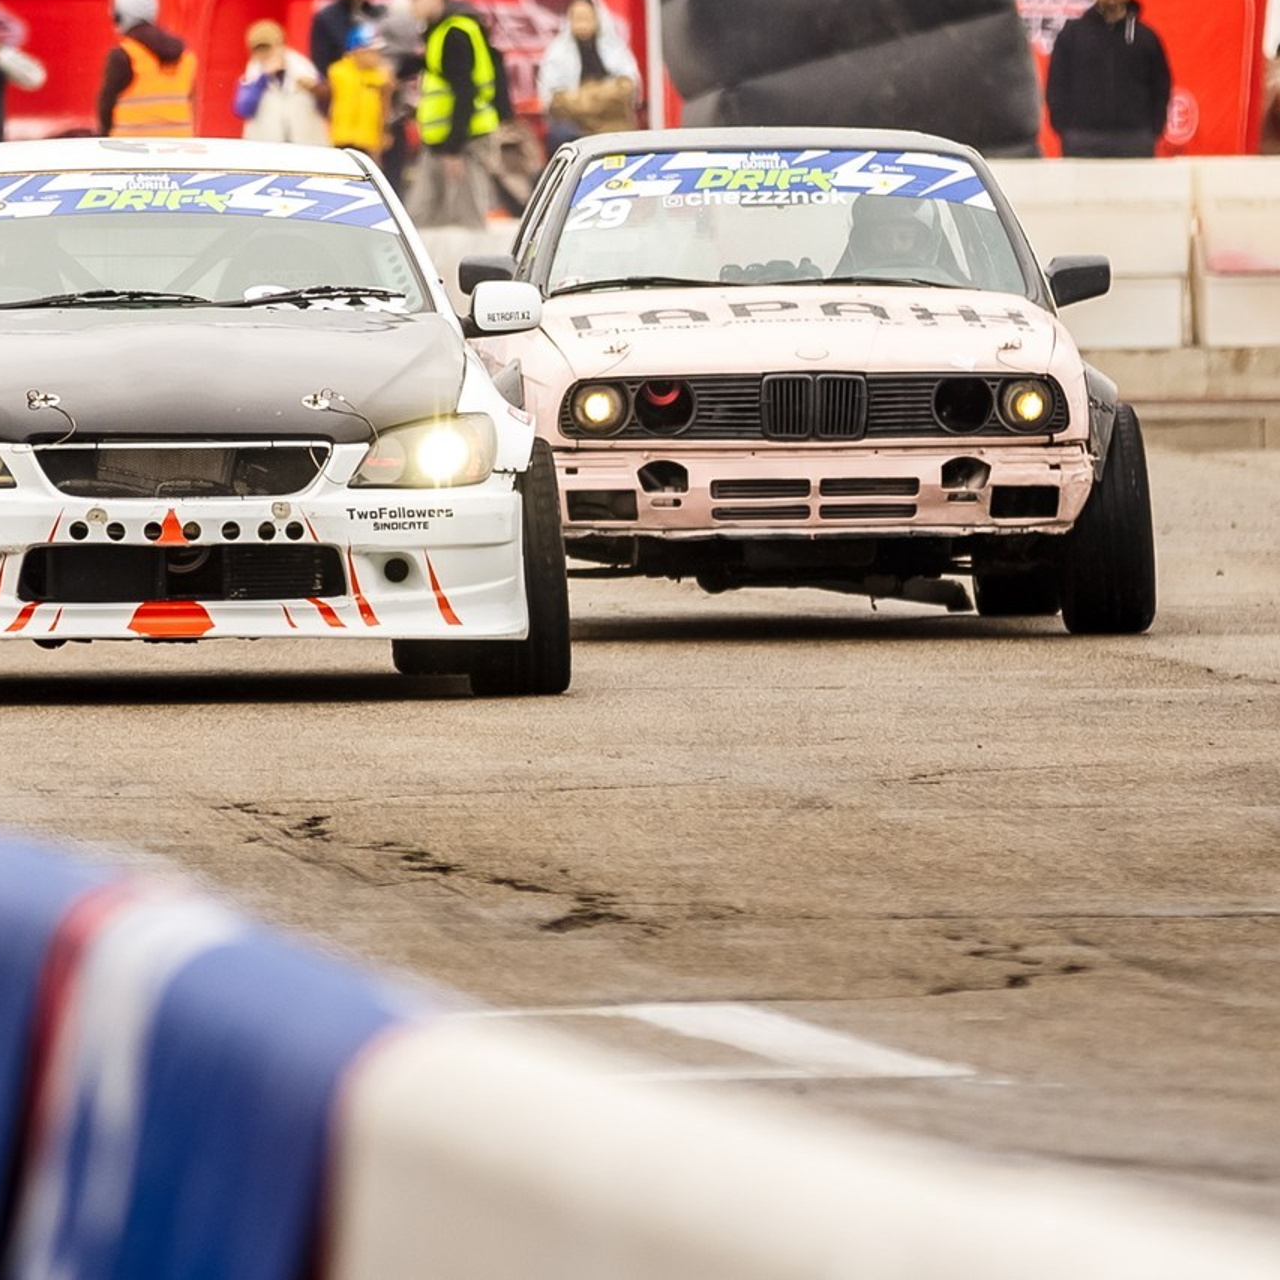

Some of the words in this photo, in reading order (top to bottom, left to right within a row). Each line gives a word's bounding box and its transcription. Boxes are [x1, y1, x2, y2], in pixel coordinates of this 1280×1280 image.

[742, 159, 789, 170] GORILLA
[128, 180, 180, 190] GORILLA
[685, 188, 847, 206] chezzznok
[562, 198, 633, 232] 29
[346, 507, 454, 520] TwoFollowers
[373, 520, 430, 531] SINDICATE
